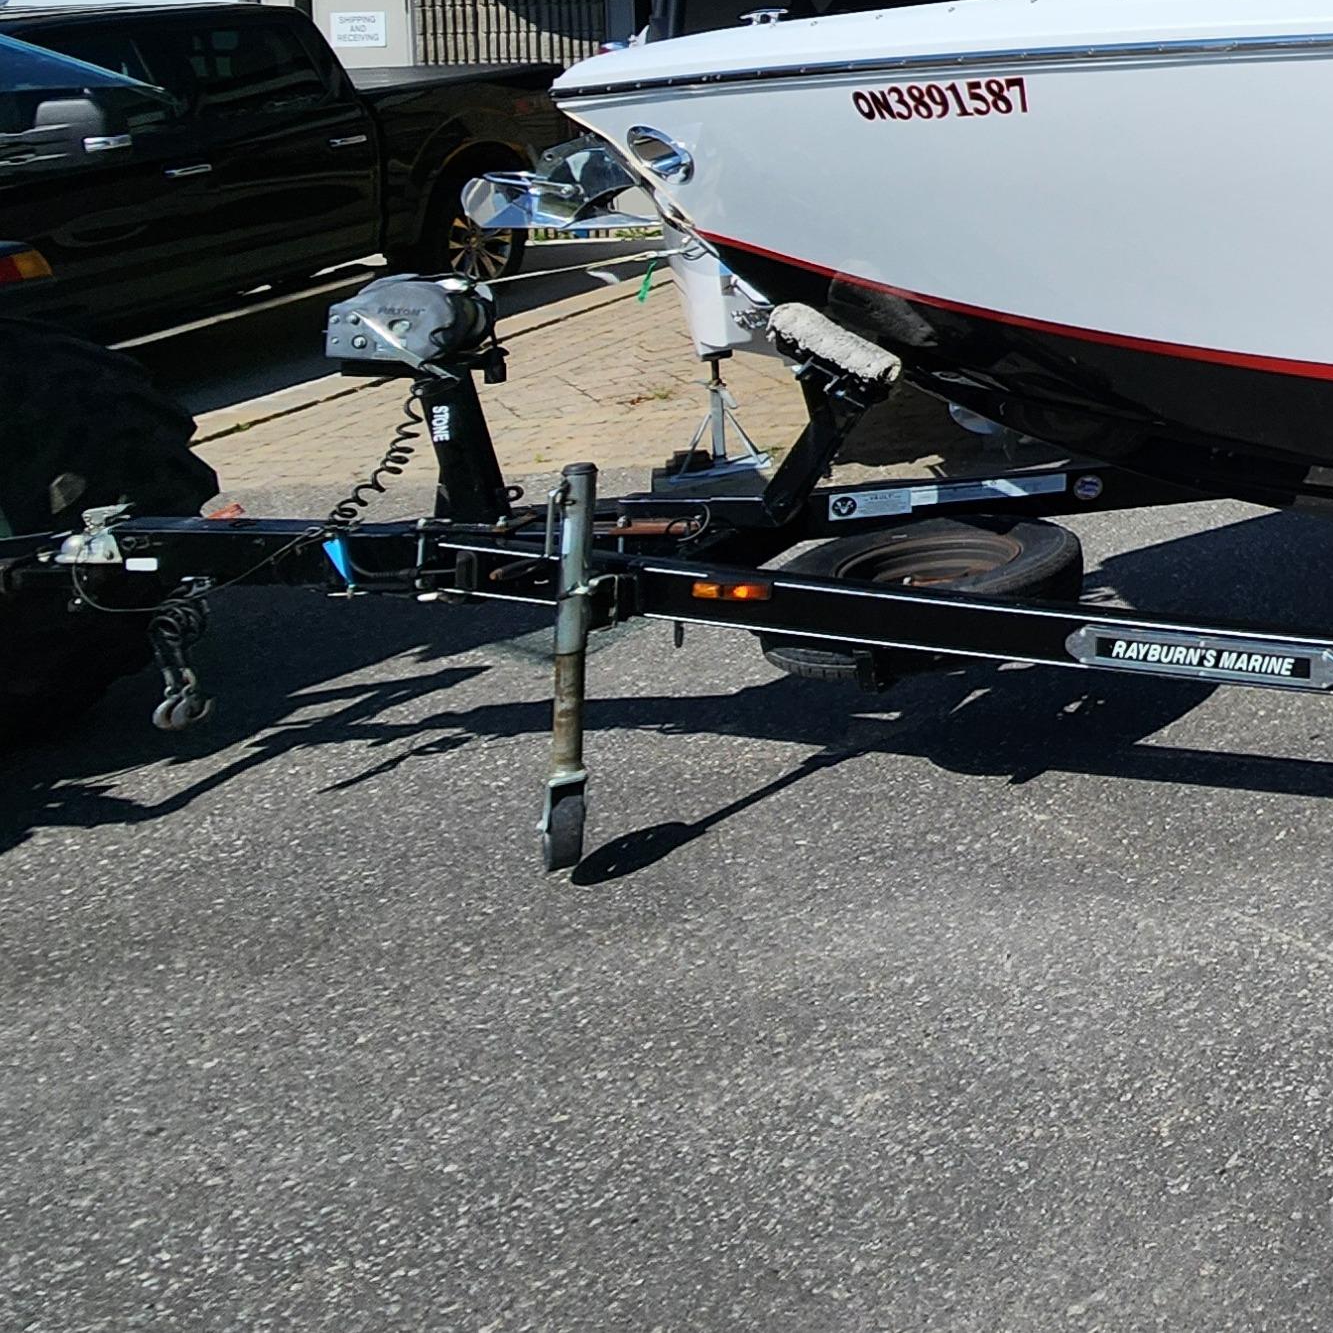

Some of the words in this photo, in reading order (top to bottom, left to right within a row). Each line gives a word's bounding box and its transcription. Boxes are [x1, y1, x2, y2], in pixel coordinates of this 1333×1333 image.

[338, 15, 377, 24] SHIPPING
[350, 24, 368, 33] AND
[336, 33, 380, 42] RECEIVING
[852, 77, 1028, 121] ON3891587
[432, 405, 450, 443] STONE
[1112, 640, 1216, 668] RAYBURN'S
[1208, 651, 1295, 676] MARINE
